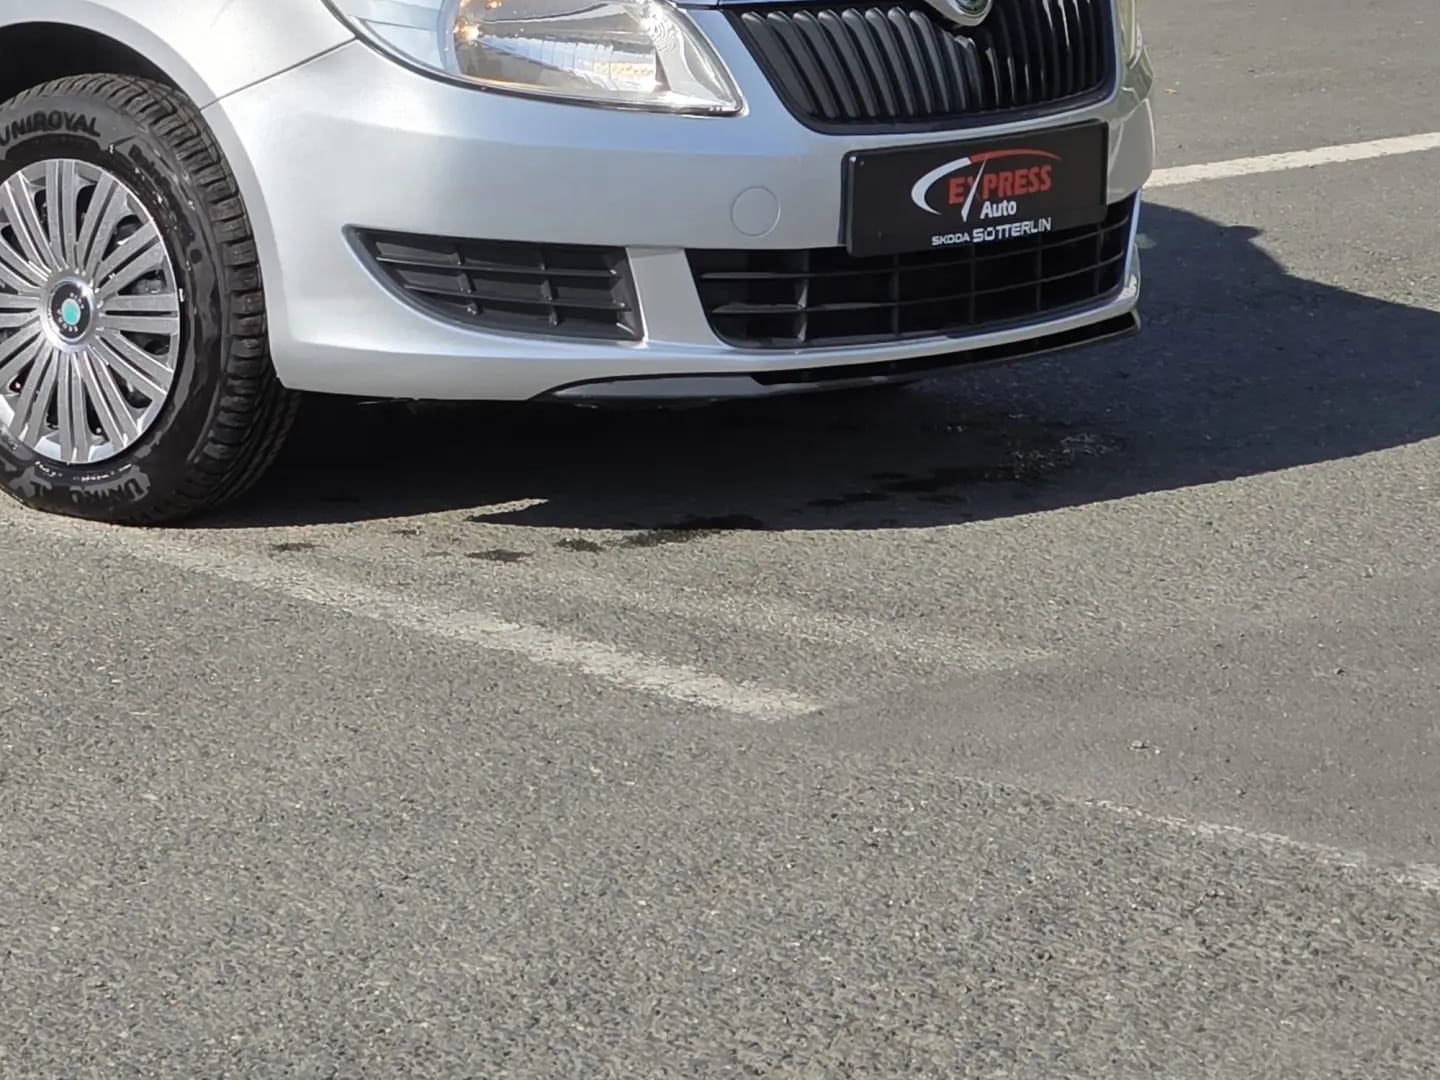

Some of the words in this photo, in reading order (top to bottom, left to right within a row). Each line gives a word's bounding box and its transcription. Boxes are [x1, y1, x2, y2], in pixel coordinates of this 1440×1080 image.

[948, 164, 1052, 205] EXPRESS
[980, 200, 1017, 219] Auto
[931, 232, 970, 246] SKODA
